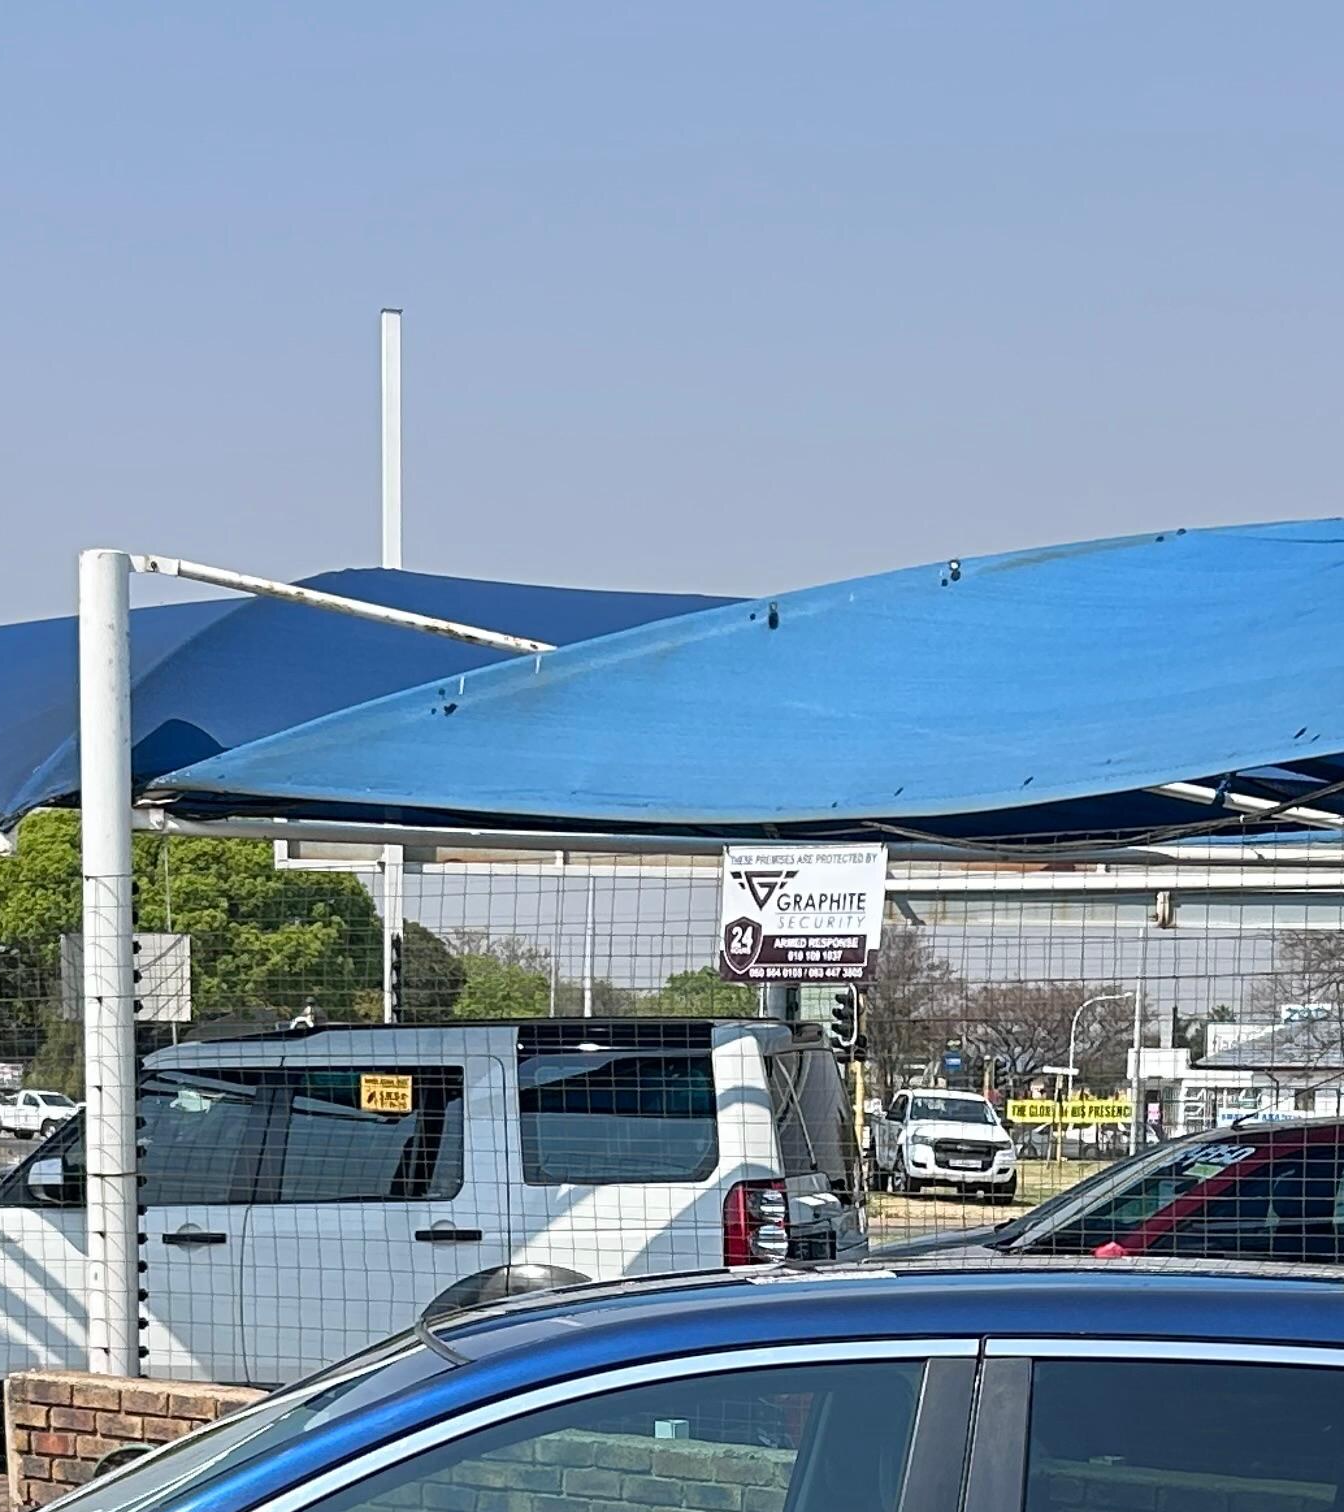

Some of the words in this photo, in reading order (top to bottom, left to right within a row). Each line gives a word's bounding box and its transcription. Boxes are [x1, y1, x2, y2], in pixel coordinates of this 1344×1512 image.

[815, 852, 864, 864] PROTECTED
[865, 852, 878, 864] BY
[776, 892, 867, 912] GRAPHITE
[778, 915, 866, 929] SECURITY
[731, 926, 754, 948] 24
[1011, 1105, 1026, 1118] THE
